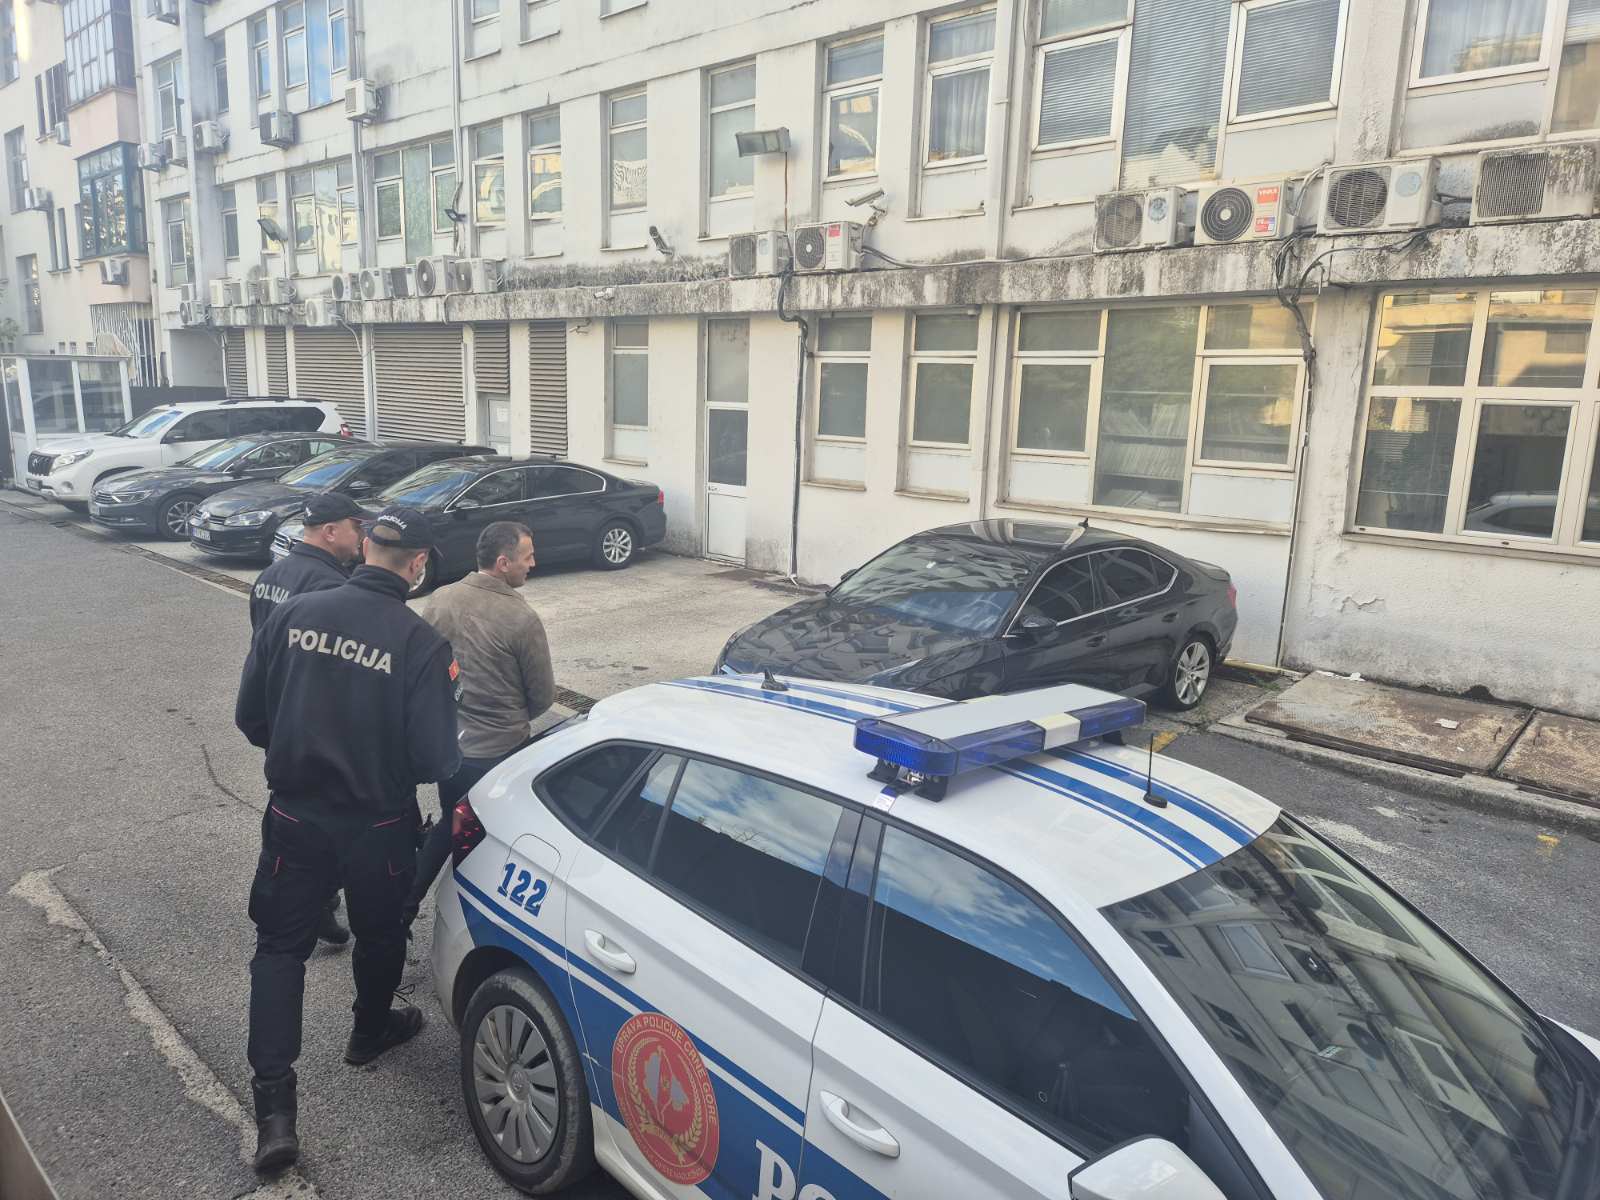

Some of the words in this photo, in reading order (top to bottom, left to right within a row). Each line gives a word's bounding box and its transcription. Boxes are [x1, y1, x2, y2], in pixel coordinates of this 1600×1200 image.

[288, 628, 392, 674] POLICIJA
[497, 862, 548, 918] 122
[616, 1019, 642, 1055] UPRAVA
[643, 1015, 684, 1042] POLICIJE
[683, 1040, 705, 1080] CRNE
[702, 1082, 717, 1124] GORE
